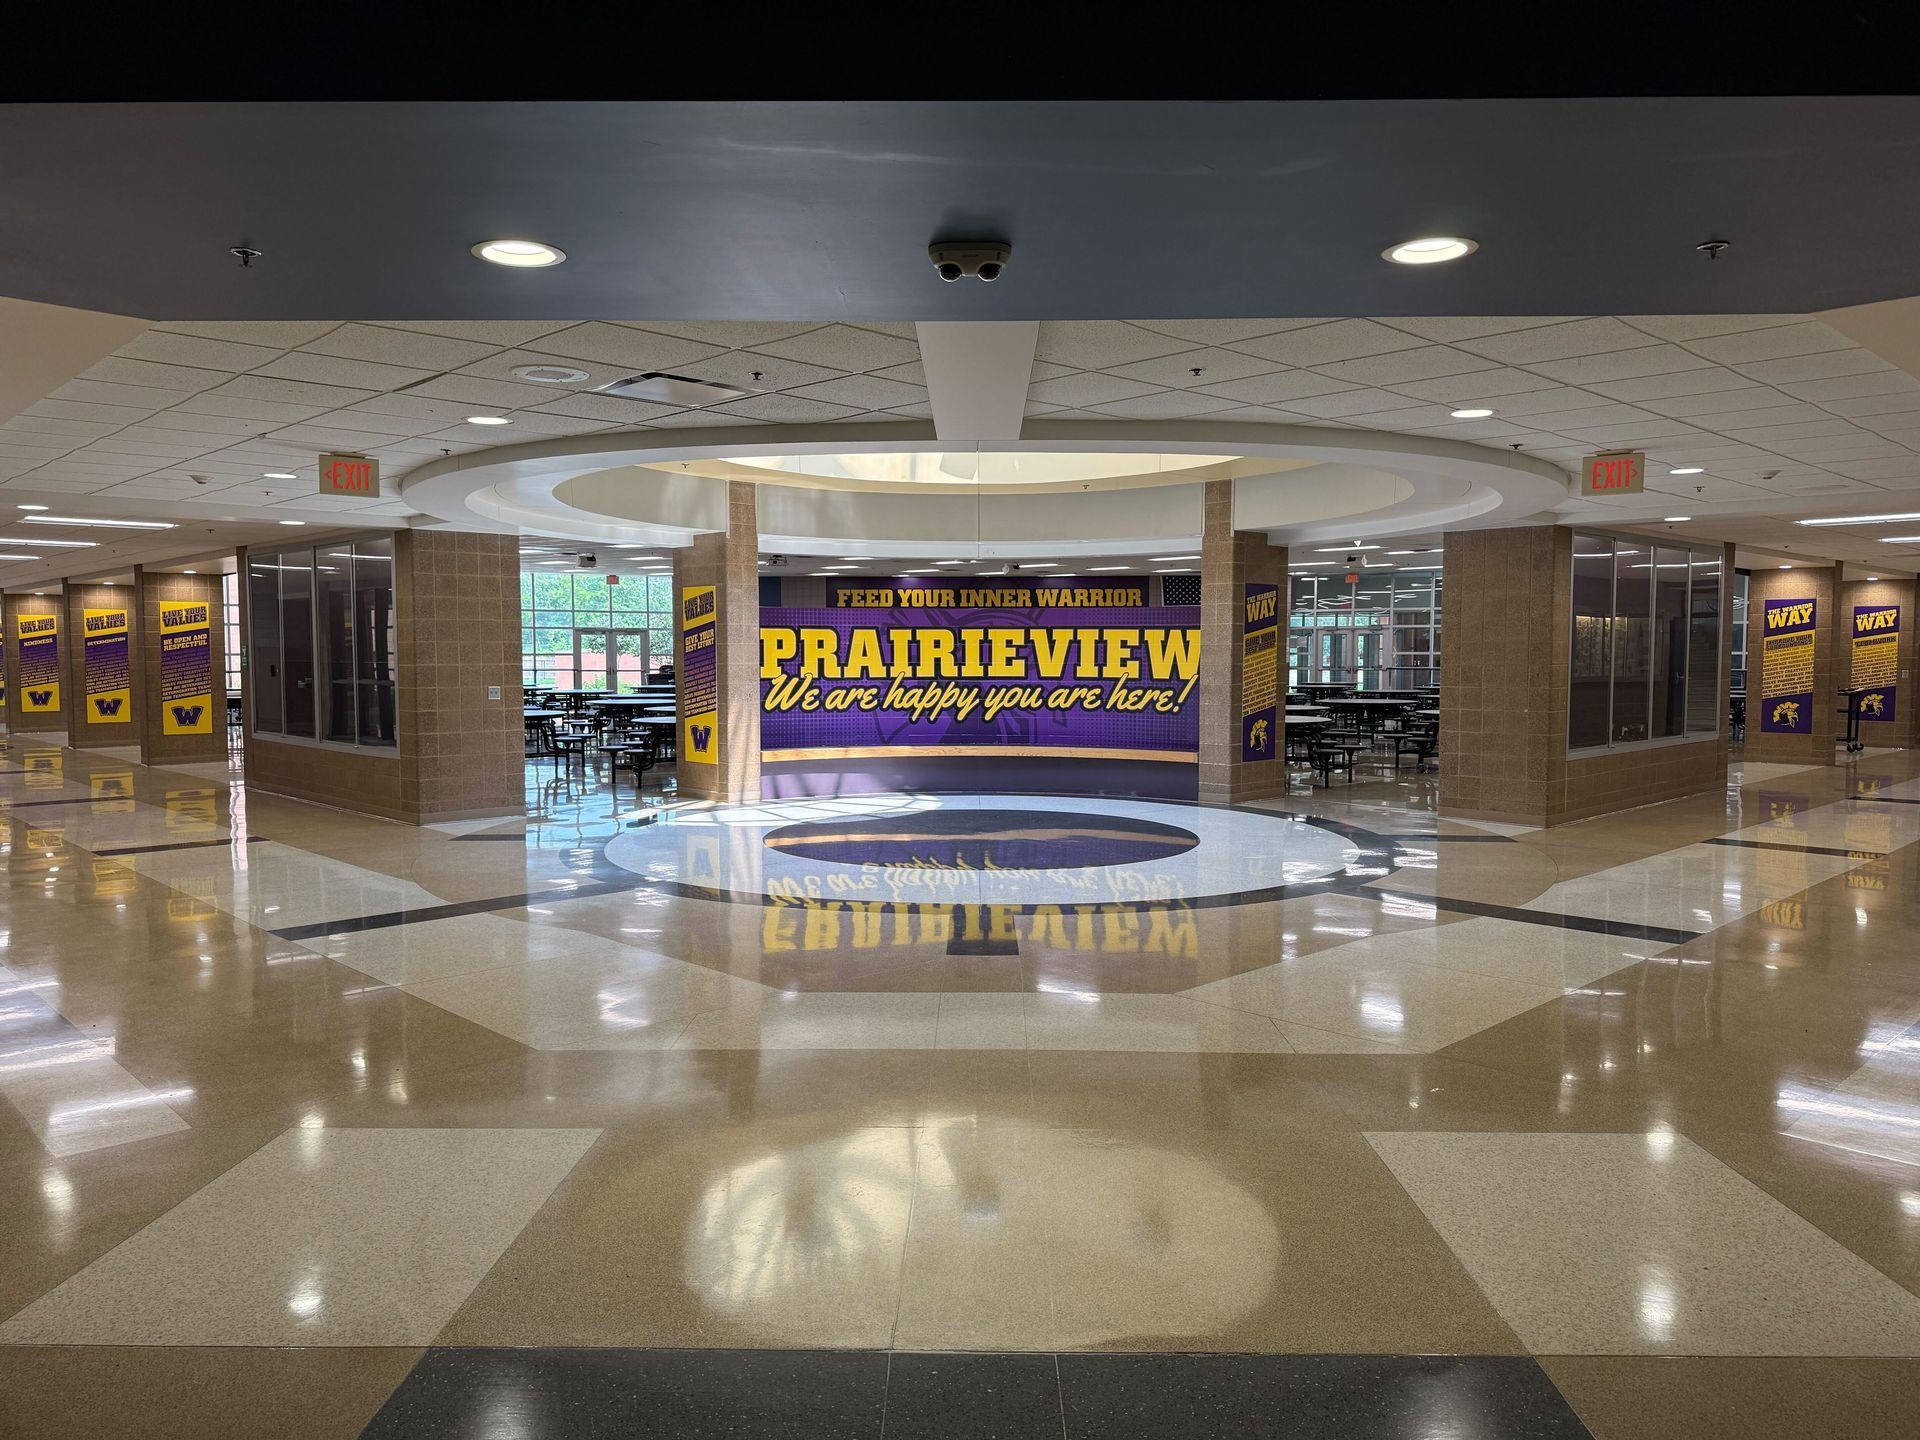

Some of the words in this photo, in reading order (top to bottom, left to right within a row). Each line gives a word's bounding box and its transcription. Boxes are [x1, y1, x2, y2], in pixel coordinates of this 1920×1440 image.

[332, 461, 372, 491] EXIT
[1592, 460, 1634, 489] EXIT
[685, 595, 698, 608] LIVE
[699, 590, 714, 603] YOUR
[836, 588, 893, 608] FEED
[898, 588, 955, 608] YOUR
[959, 588, 1031, 608] INNER
[1035, 588, 1143, 608] WARRIOR
[1247, 595, 1256, 604] THE
[1256, 590, 1277, 601] WARRIOR
[162, 608, 183, 618] LIVE
[184, 605, 206, 616] YOUR
[685, 600, 714, 621] VALUES
[1246, 596, 1277, 623] WAY
[1782, 602, 1813, 613] WARRIOR
[1869, 609, 1897, 617] WARRIOR
[86, 616, 104, 624] LIVE
[106, 613, 125, 621] YOUR
[86, 620, 126, 631] VALUES
[163, 613, 207, 627] VALUES
[1767, 607, 1814, 629] WAY
[1856, 613, 1897, 632] WAY
[21, 623, 55, 634] VALUES
[23, 638, 53, 647] KINDNESS
[87, 637, 126, 647] DETERMINATION
[173, 635, 192, 644] OPEN
[193, 633, 208, 641] AND
[685, 633, 699, 646] GIVE
[699, 628, 714, 641] YOUR
[1245, 637, 1260, 648] GIVE
[1260, 631, 1276, 643] YOUR
[1855, 636, 1897, 647] TEAMWORK
[163, 640, 208, 651] RESPECTFUL
[685, 643, 697, 653] BEST
[697, 638, 714, 649] EFFORT
[760, 627, 1200, 680] PRAIRIEVIEW
[28, 691, 53, 706] W
[764, 672, 820, 711] We
[825, 686, 878, 710] are
[882, 671, 979, 722] happy
[984, 686, 1042, 721] you
[1048, 686, 1101, 710] are
[1106, 672, 1199, 713] here!
[94, 698, 124, 717] W
[171, 705, 204, 727] W
[690, 724, 712, 753] W
